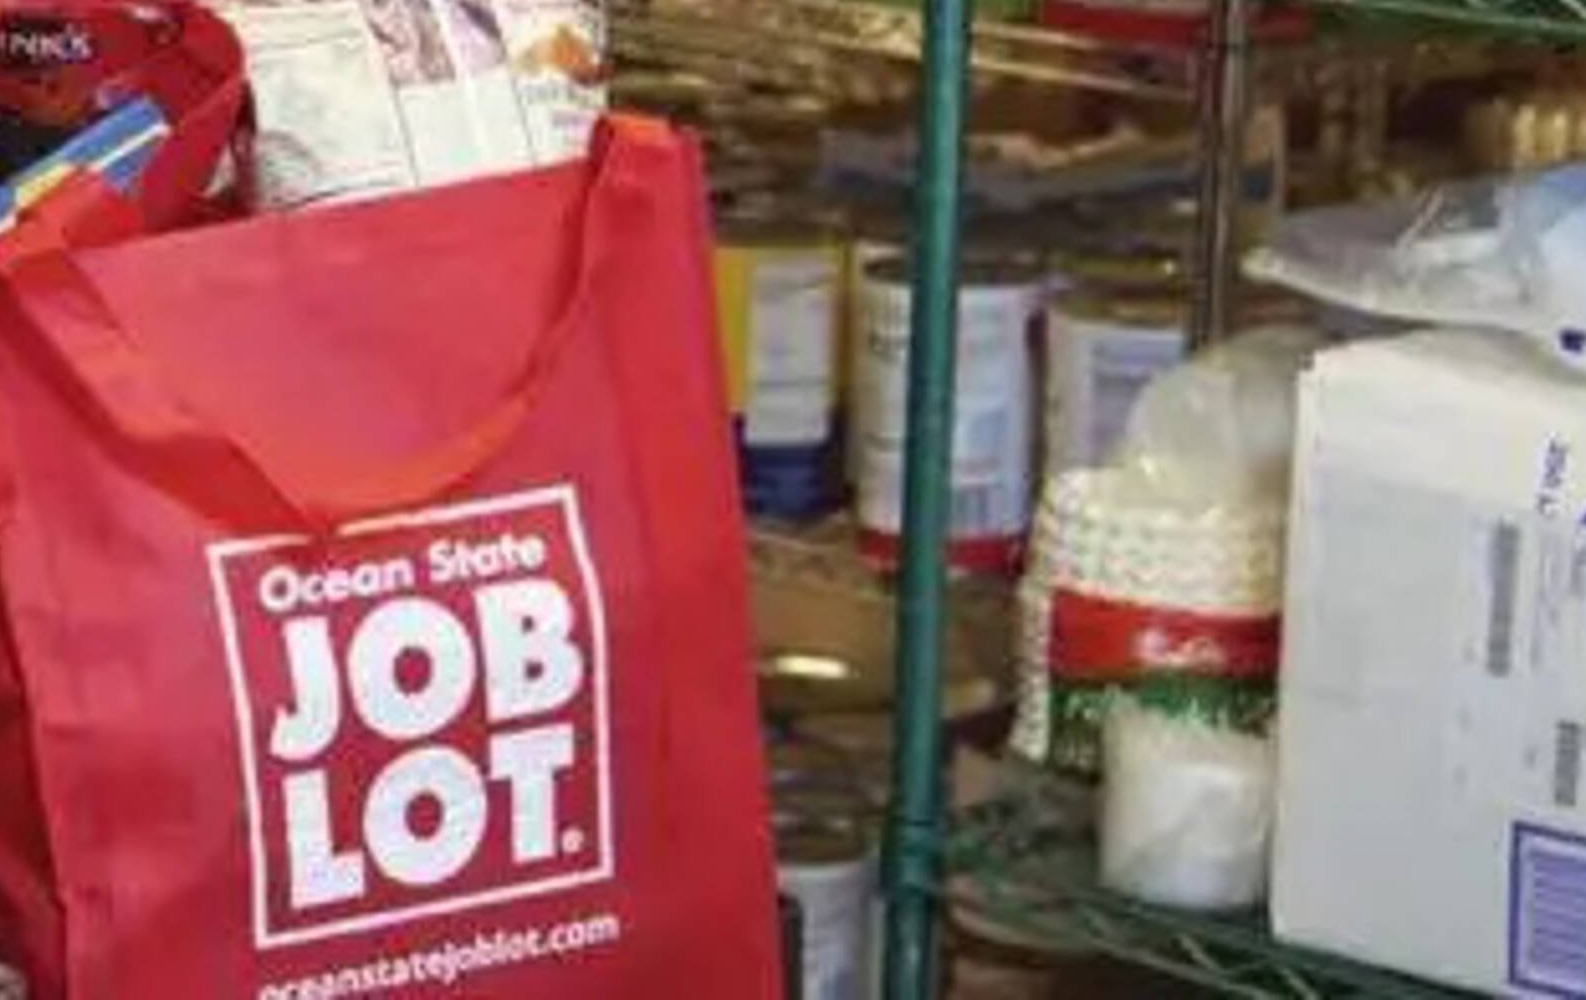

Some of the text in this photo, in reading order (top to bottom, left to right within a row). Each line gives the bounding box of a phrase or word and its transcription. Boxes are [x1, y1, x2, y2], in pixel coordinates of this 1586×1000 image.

[258, 531, 547, 613] Ocean State
[269, 578, 583, 761] JOB
